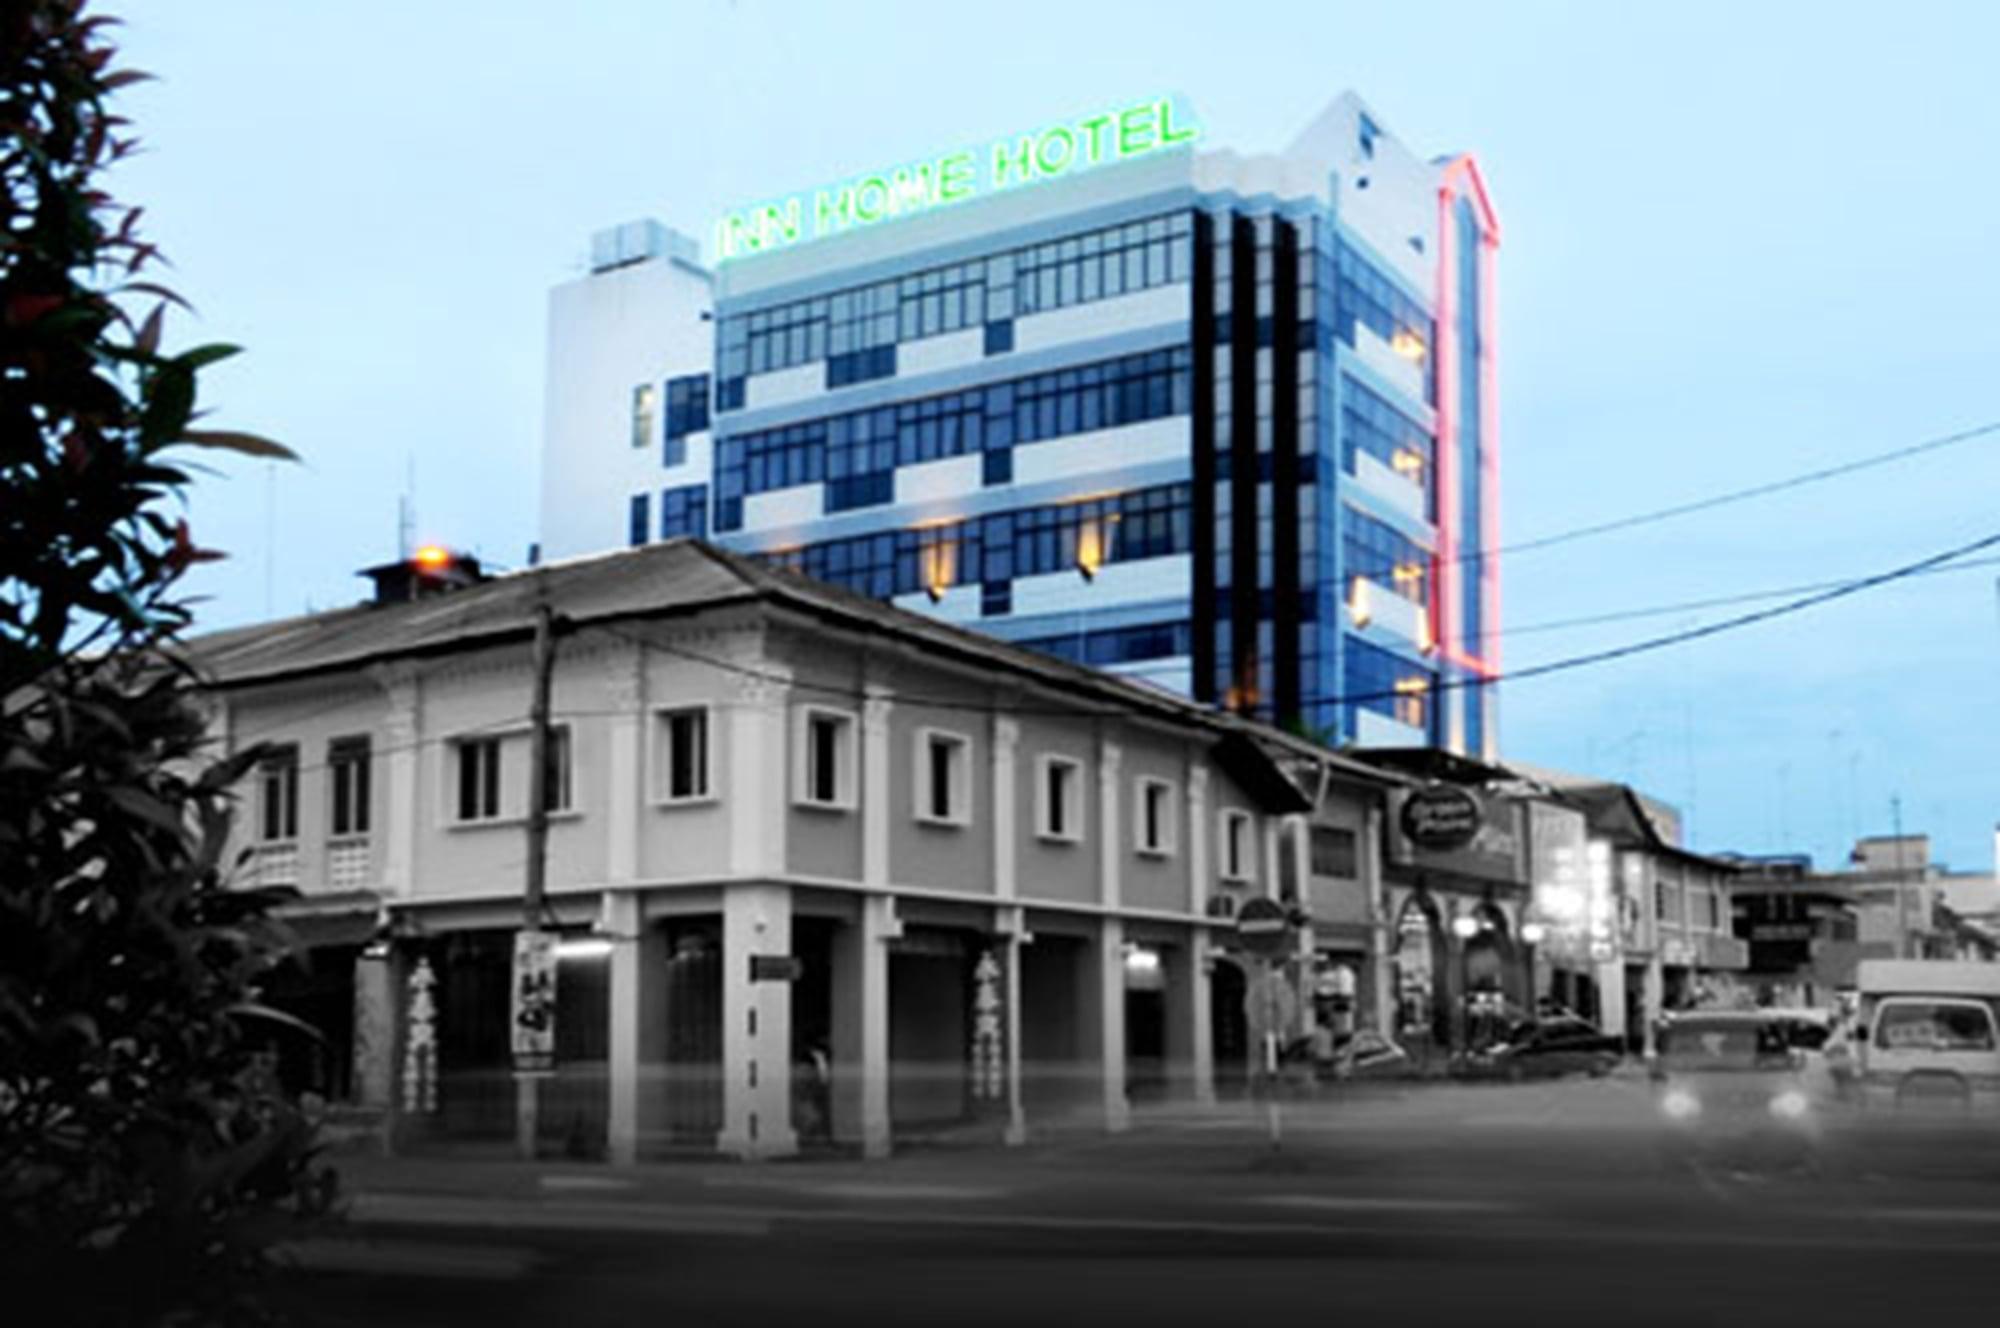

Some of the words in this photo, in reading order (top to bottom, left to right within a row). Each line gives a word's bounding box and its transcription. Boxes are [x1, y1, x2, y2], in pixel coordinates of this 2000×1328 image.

[717, 201, 802, 257] INN
[818, 153, 972, 229] HOME
[995, 100, 1195, 184] HOTEL
